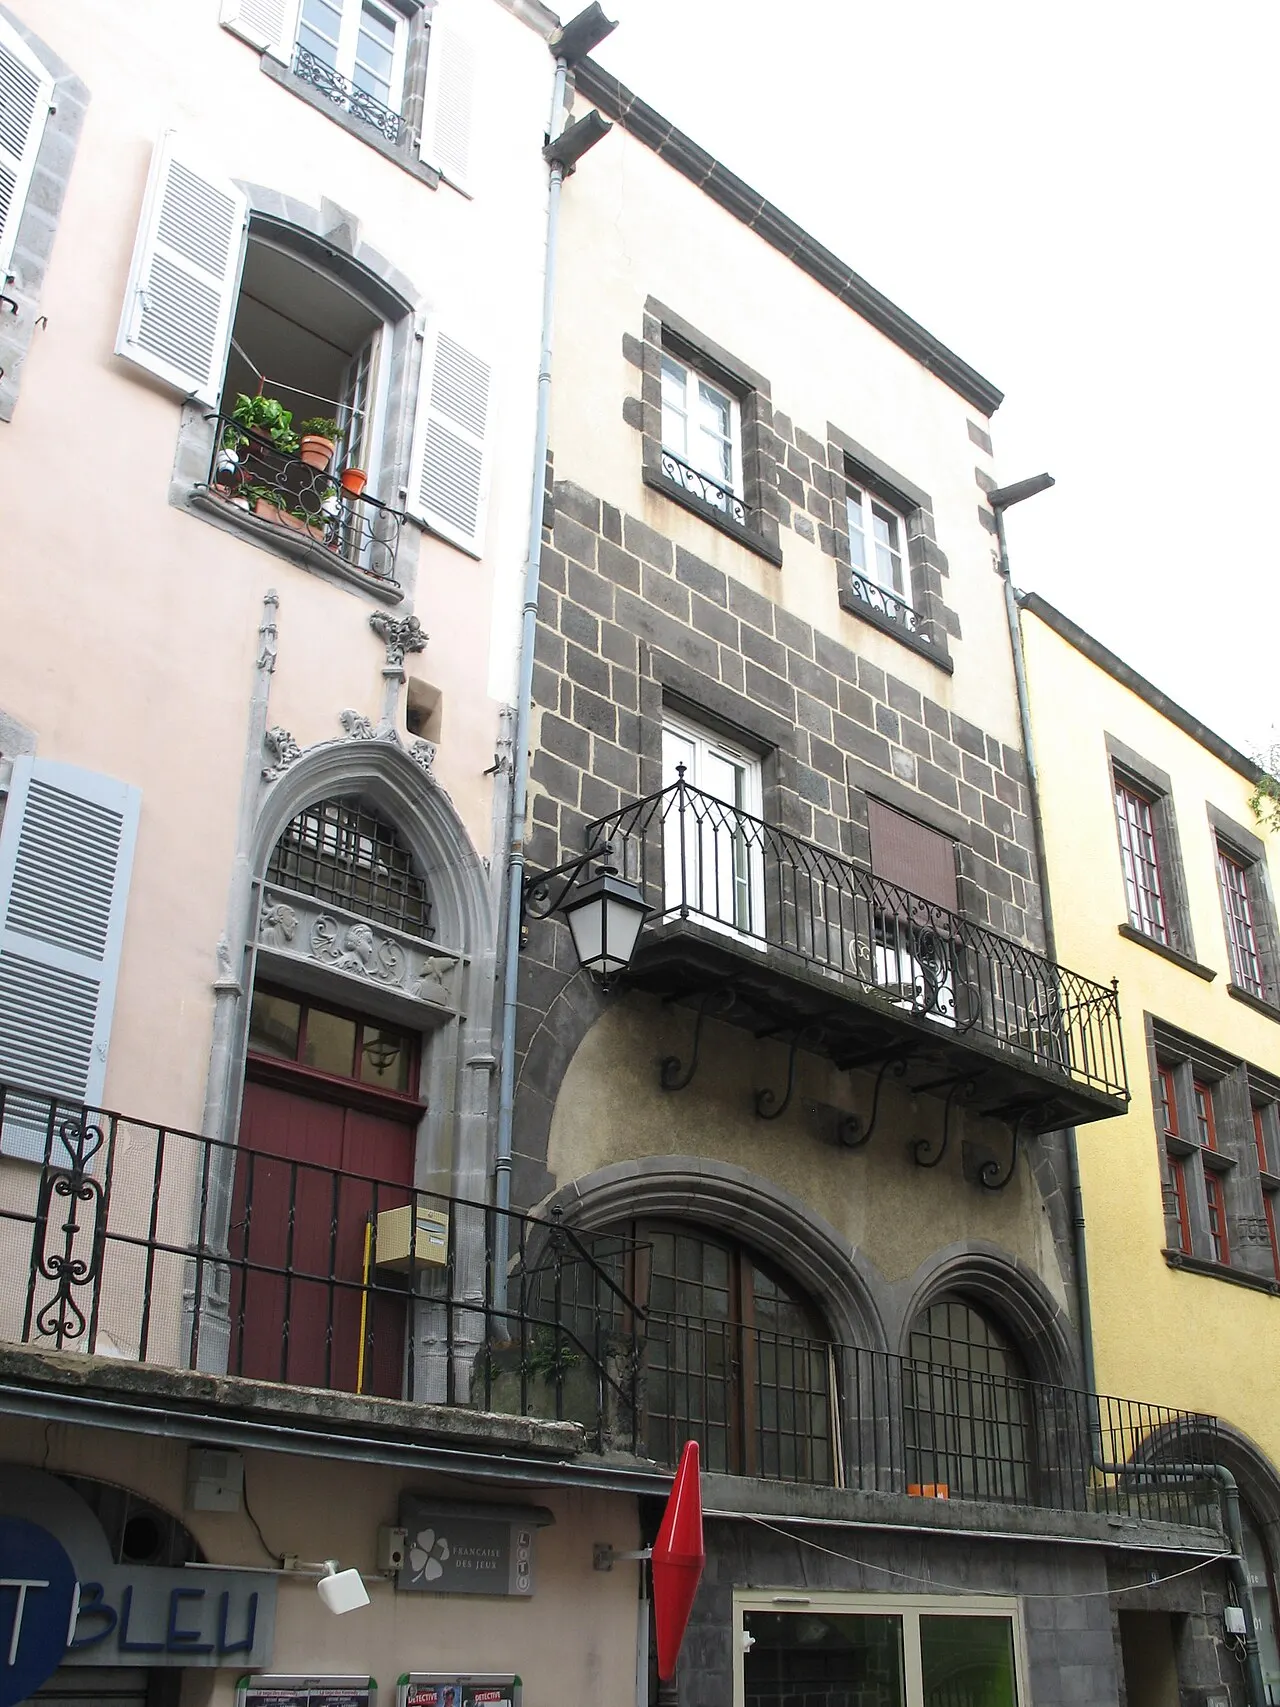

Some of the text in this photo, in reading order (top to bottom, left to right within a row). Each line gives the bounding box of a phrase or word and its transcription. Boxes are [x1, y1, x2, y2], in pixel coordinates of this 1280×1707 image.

[455, 1559, 497, 1570] DES JEUX
[66, 1580, 259, 1653] BLEU
